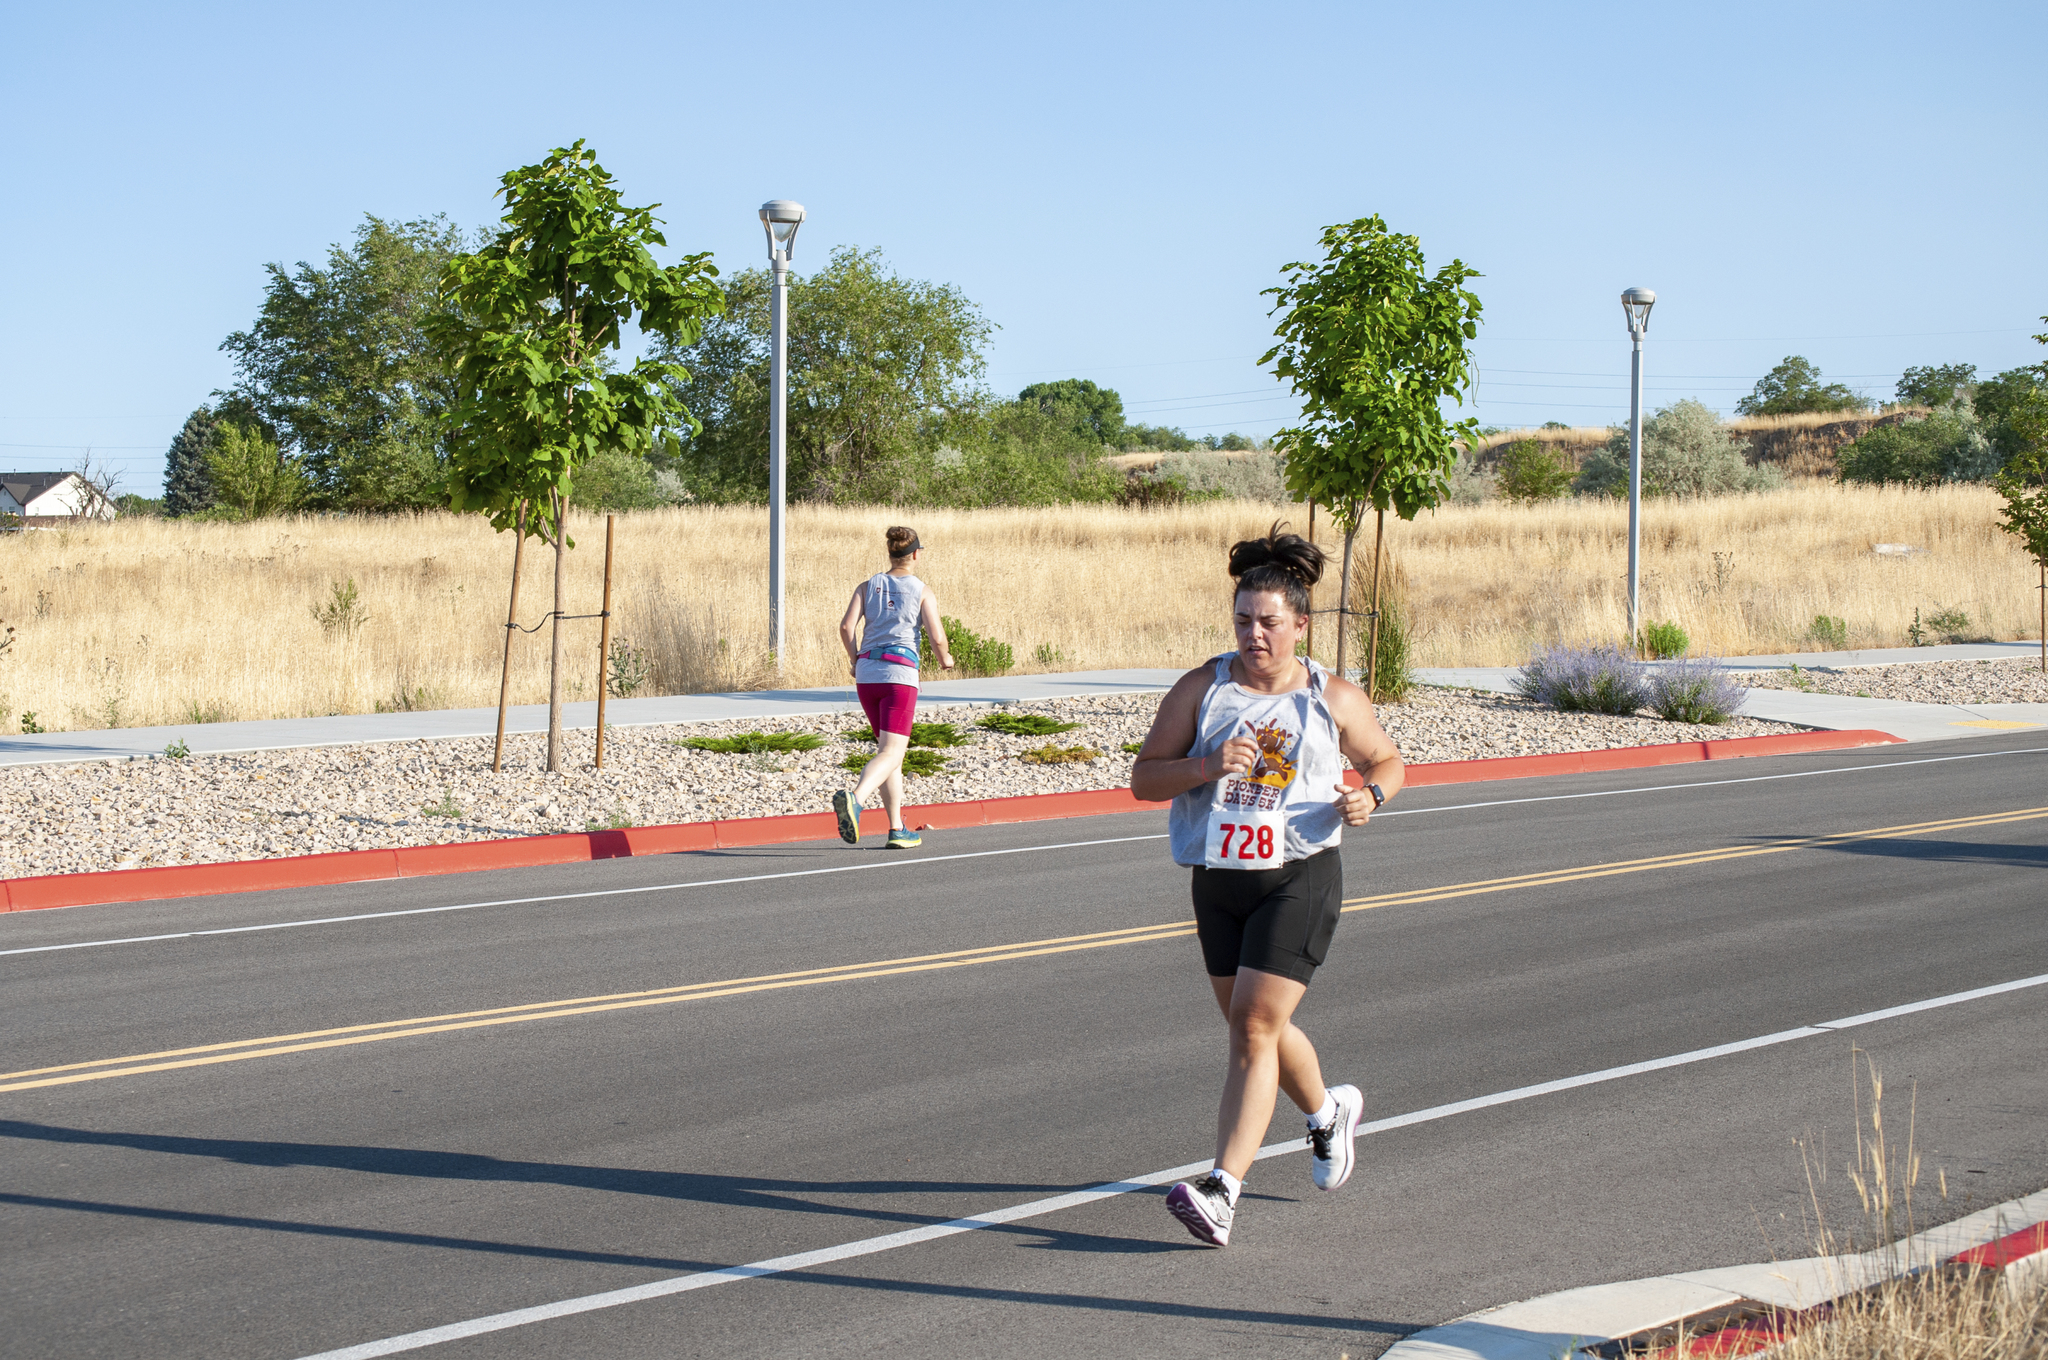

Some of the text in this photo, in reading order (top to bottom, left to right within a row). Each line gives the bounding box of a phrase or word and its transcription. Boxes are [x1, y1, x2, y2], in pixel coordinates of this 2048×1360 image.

[1226, 779, 1280, 798] PIONEER
[1224, 792, 1276, 810] DAYS 5K
[1219, 823, 1274, 859] 728
